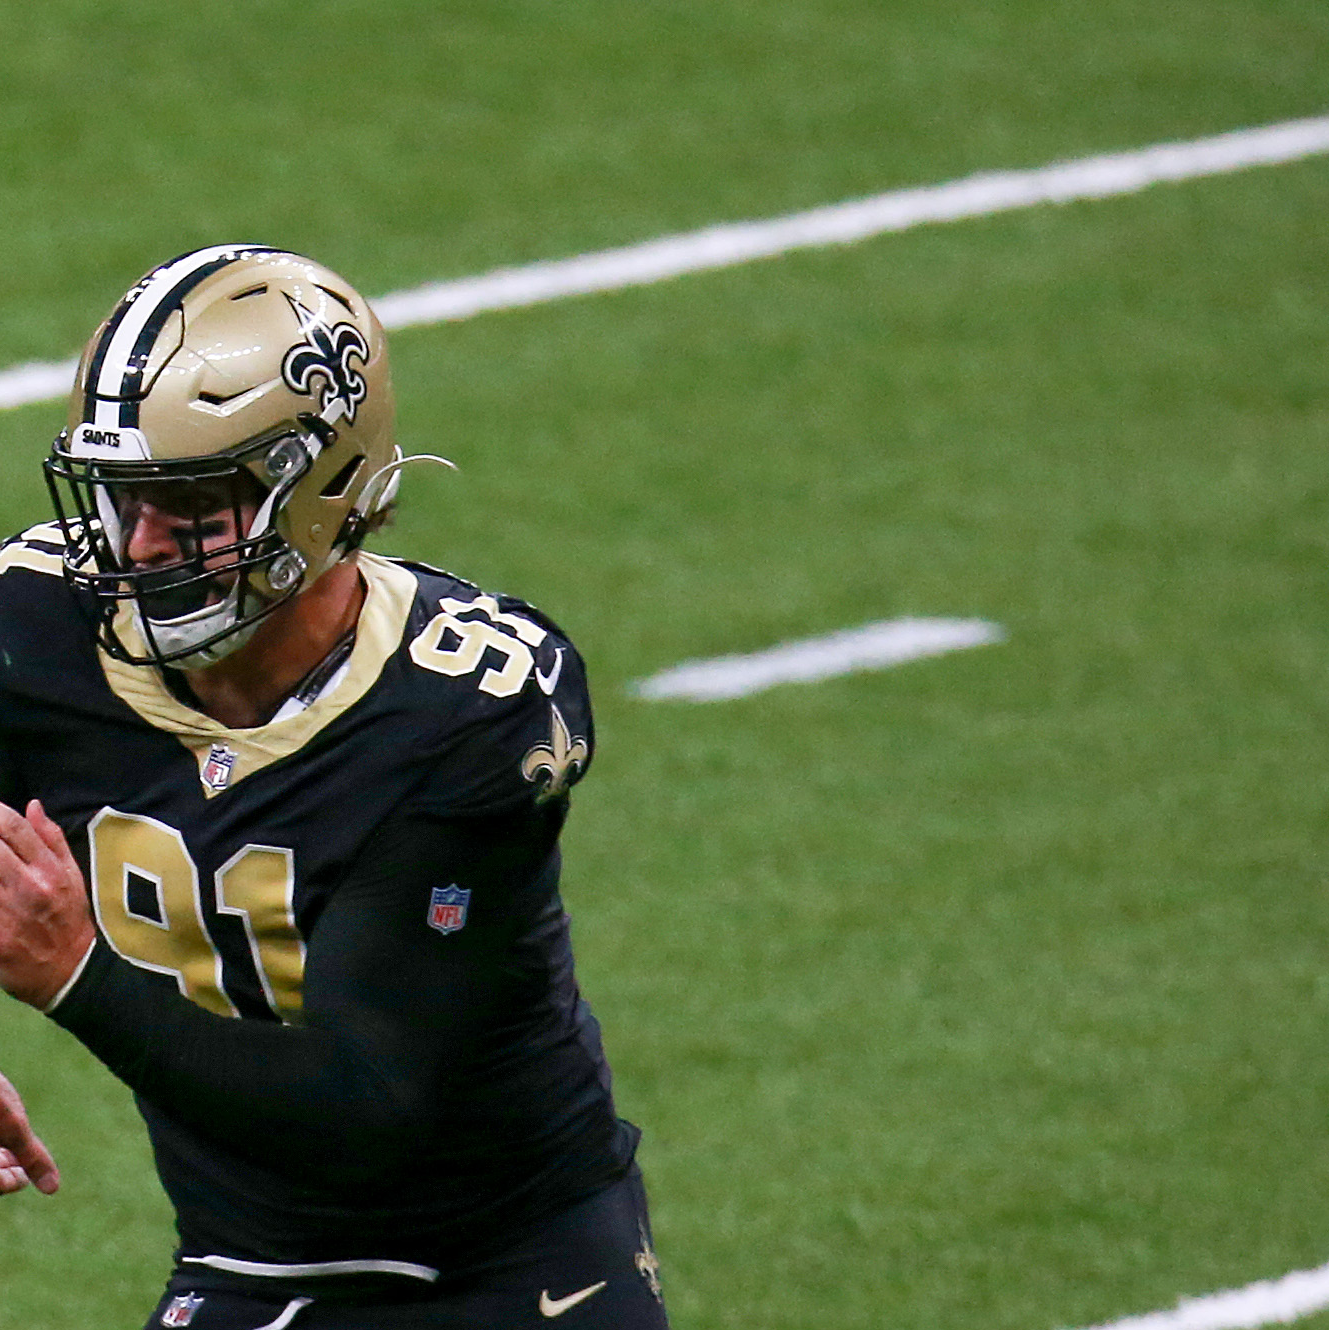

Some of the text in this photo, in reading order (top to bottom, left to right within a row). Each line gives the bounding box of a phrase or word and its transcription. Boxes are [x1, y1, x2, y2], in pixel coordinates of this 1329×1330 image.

[408, 596, 548, 698] 91
[87, 805, 308, 1027] 91
[433, 905, 462, 927] NFL
